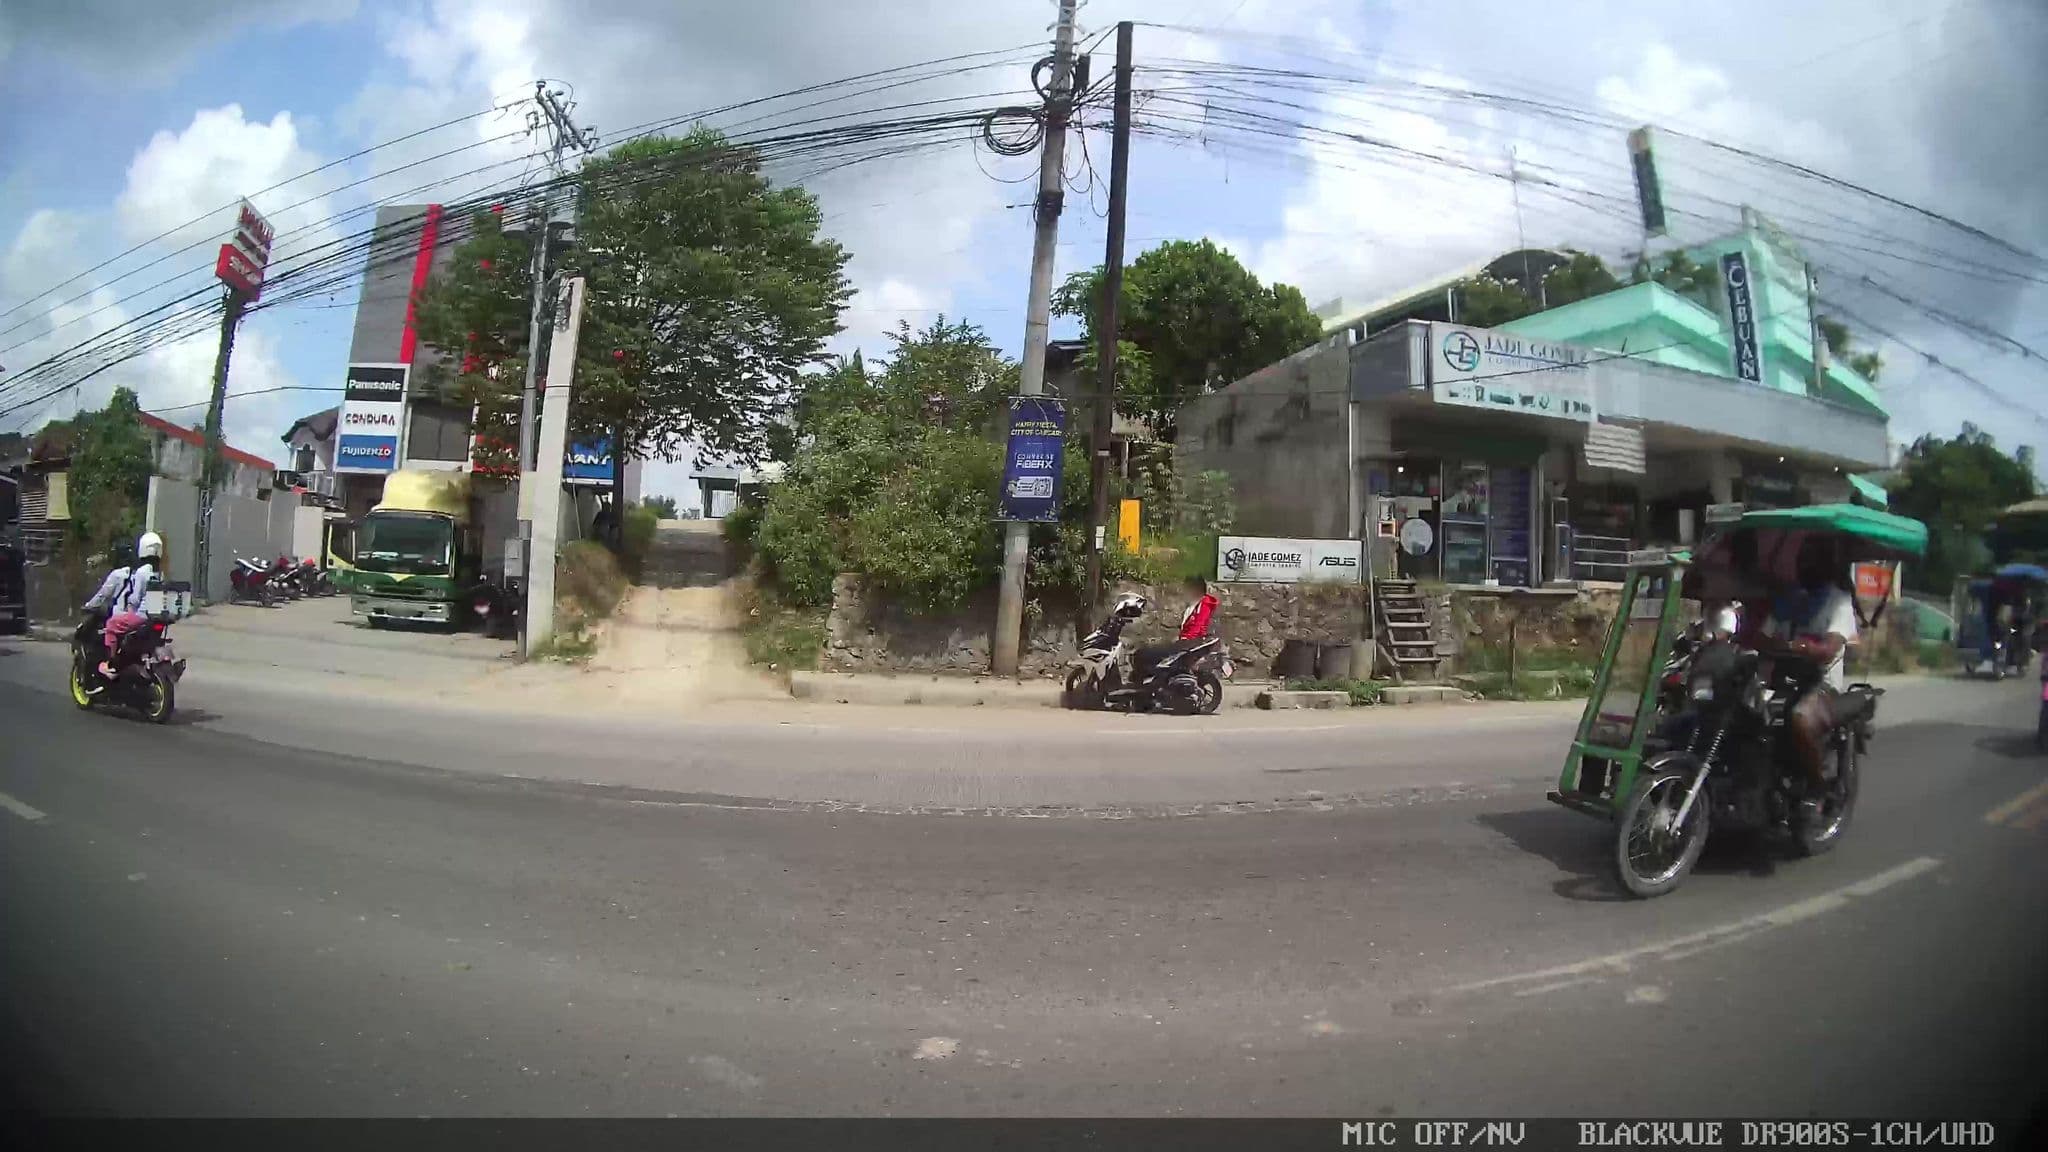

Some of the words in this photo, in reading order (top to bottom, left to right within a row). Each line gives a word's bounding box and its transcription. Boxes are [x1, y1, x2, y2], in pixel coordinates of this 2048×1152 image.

[348, 379, 402, 391] Panasonic
[345, 413, 396, 426] CONDURA
[341, 446, 392, 457] FUJIDENZO
[1271, 552, 1301, 562] GOMEZ
[1319, 556, 1357, 567] ASUS
